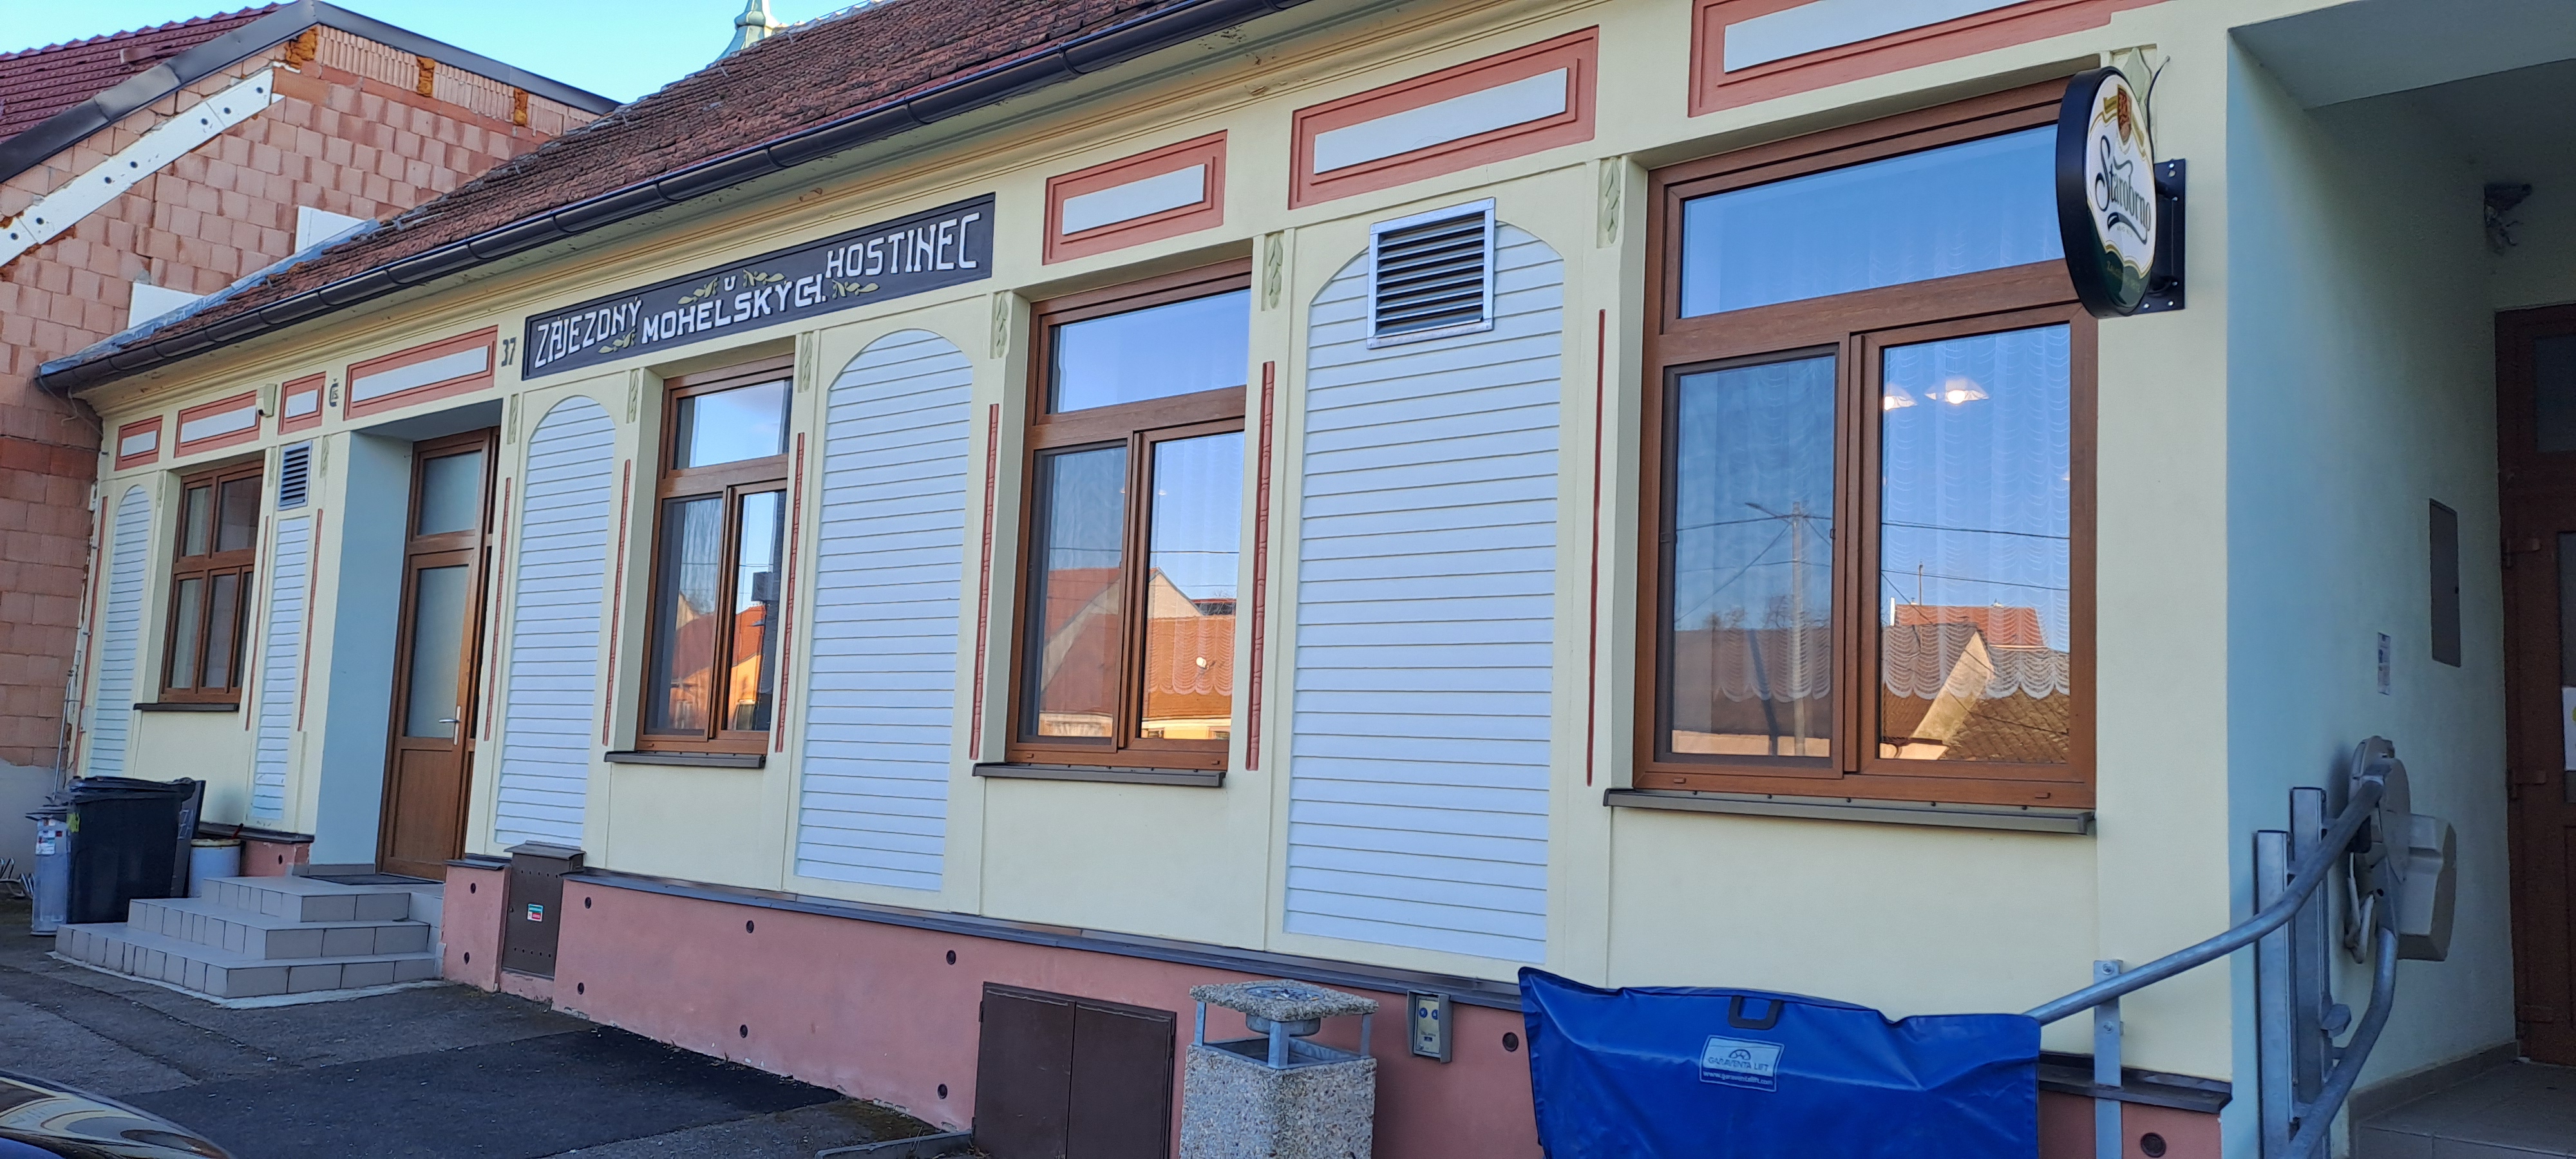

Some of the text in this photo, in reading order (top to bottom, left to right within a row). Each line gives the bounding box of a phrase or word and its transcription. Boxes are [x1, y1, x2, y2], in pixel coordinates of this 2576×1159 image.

[2095, 135, 2152, 236] Starobrno
[825, 212, 980, 279] HOSTINEC
[724, 275, 737, 292] U
[501, 337, 516, 367] 37
[535, 296, 643, 368] ZÁJEZDNÝ
